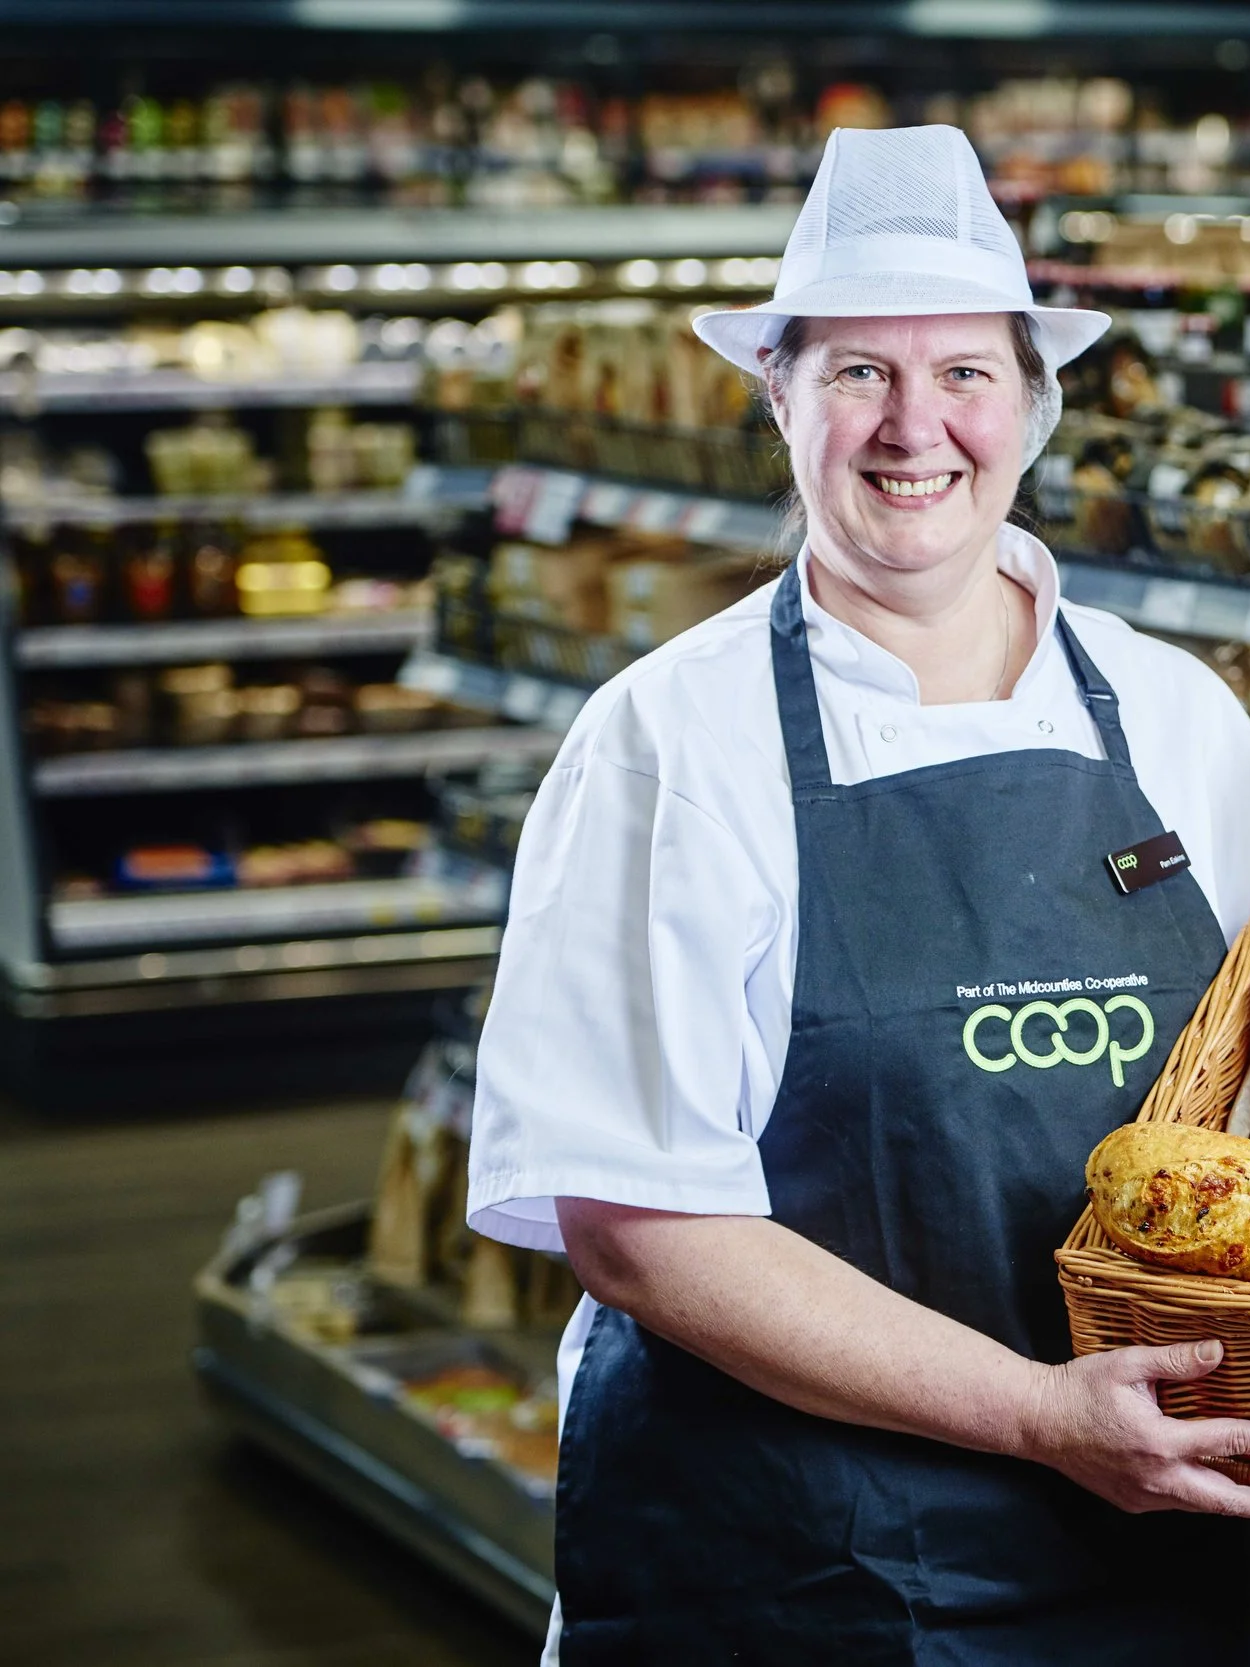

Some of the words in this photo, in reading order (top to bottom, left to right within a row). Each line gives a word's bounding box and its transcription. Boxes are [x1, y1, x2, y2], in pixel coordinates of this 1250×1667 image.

[1117, 854, 1138, 870] coop
[956, 984, 981, 998] Part
[982, 983, 995, 997] of
[997, 982, 1017, 996] The
[1018, 978, 1083, 995] Midcounties
[1084, 973, 1149, 991] Co-operative
[963, 994, 1155, 1088] coop
